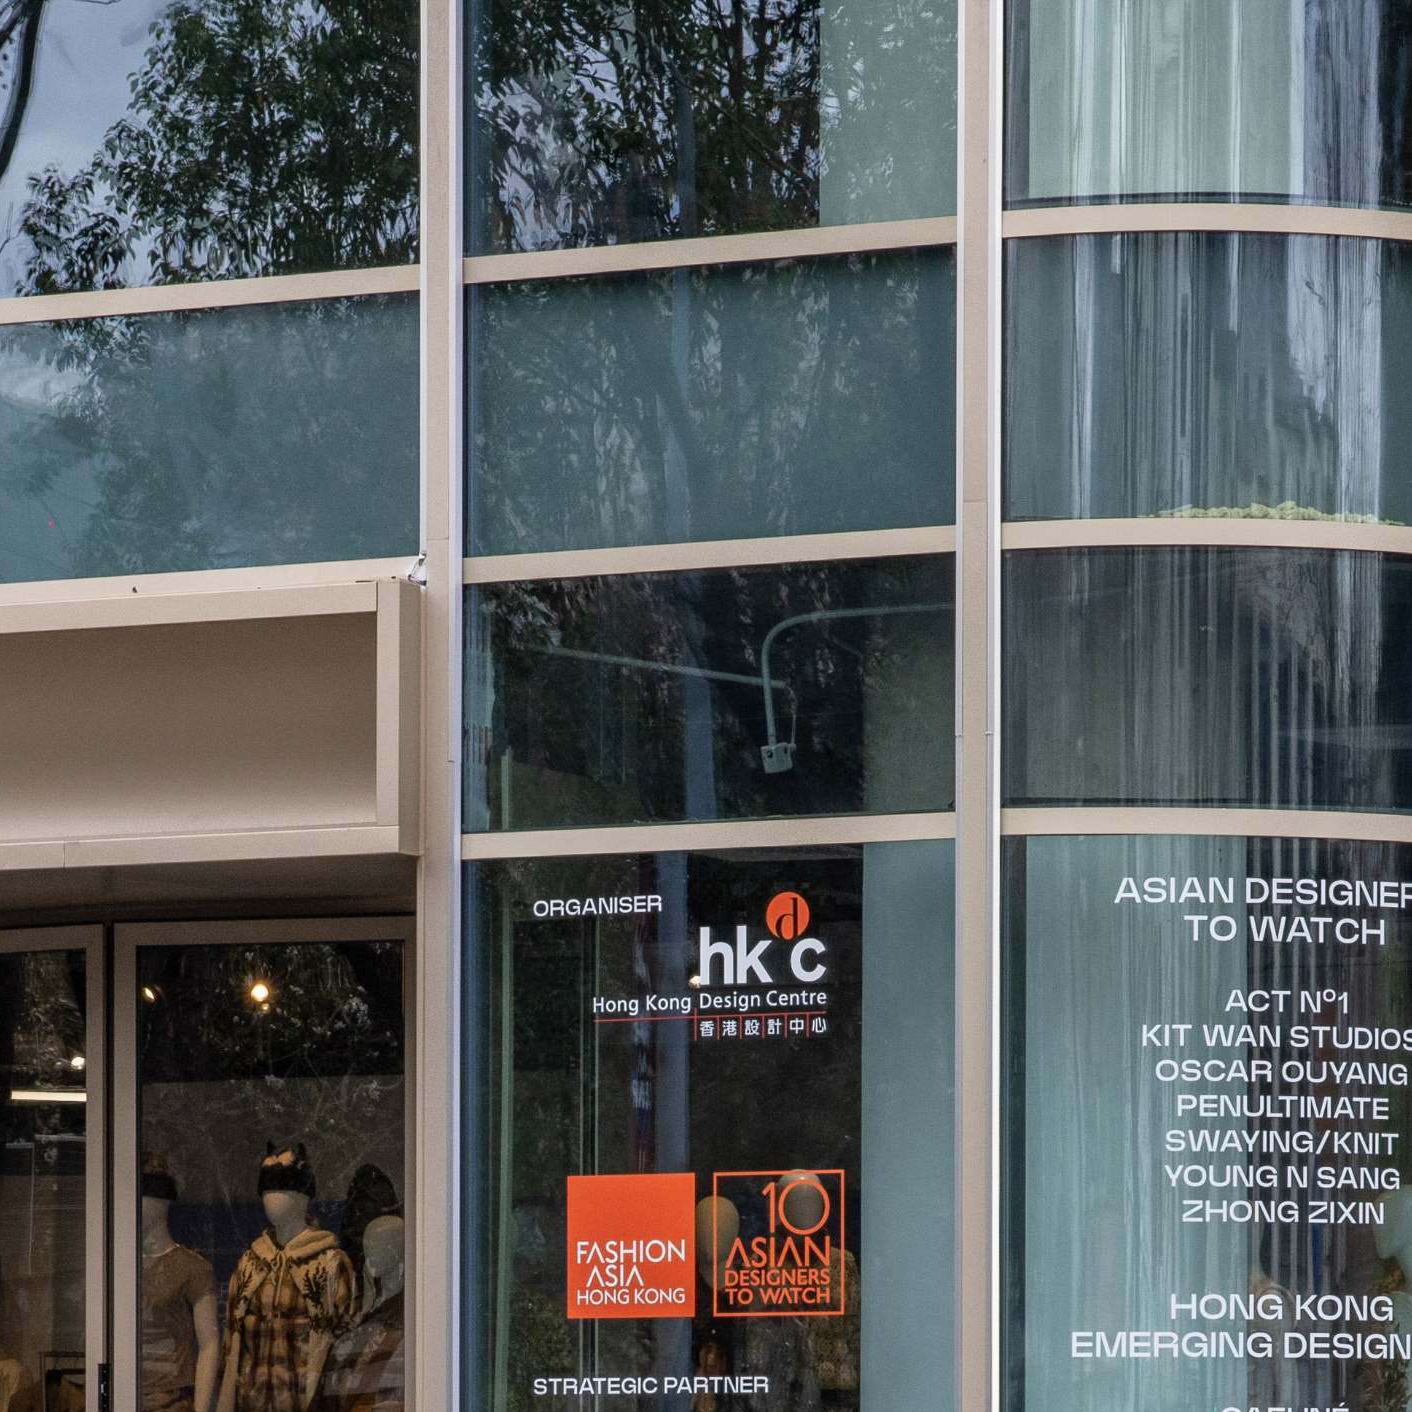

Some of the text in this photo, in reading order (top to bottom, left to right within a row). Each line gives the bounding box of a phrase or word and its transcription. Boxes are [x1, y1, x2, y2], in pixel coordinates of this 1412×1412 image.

[1113, 876, 1234, 904] ASIAN
[533, 894, 662, 917] ORGANISER
[1183, 914, 1385, 946] TO WATCH
[593, 990, 827, 1016] Hong Kong Design Centre
[1225, 989, 1291, 1013] ACT
[700, 1017, 827, 1037] 香港設計中心
[1142, 1023, 1193, 1047] KIT
[1202, 1024, 1281, 1048] WAN
[1155, 1059, 1408, 1086] OSCAR OUYANG
[1177, 1094, 1389, 1120] PENULTIMATE
[1164, 1129, 1399, 1155] SWAYING/KNIT
[1164, 1164, 1400, 1190] YOUNG N SANG
[761, 1177, 831, 1235] 10
[1181, 1199, 1384, 1225] ZHONG ZIXIN
[577, 1239, 685, 1264] FASHION
[723, 1236, 832, 1267] ASIAN
[586, 1264, 644, 1287] ASIA
[723, 1269, 832, 1287] DESIGNERS
[577, 1287, 685, 1305] HONG KONG
[723, 1288, 831, 1306] TO WATCH
[1170, 1293, 1393, 1322] HONG KONG
[1071, 1330, 1273, 1359] EMERGING
[534, 1376, 769, 1395] STRATEGIC PARTNER
